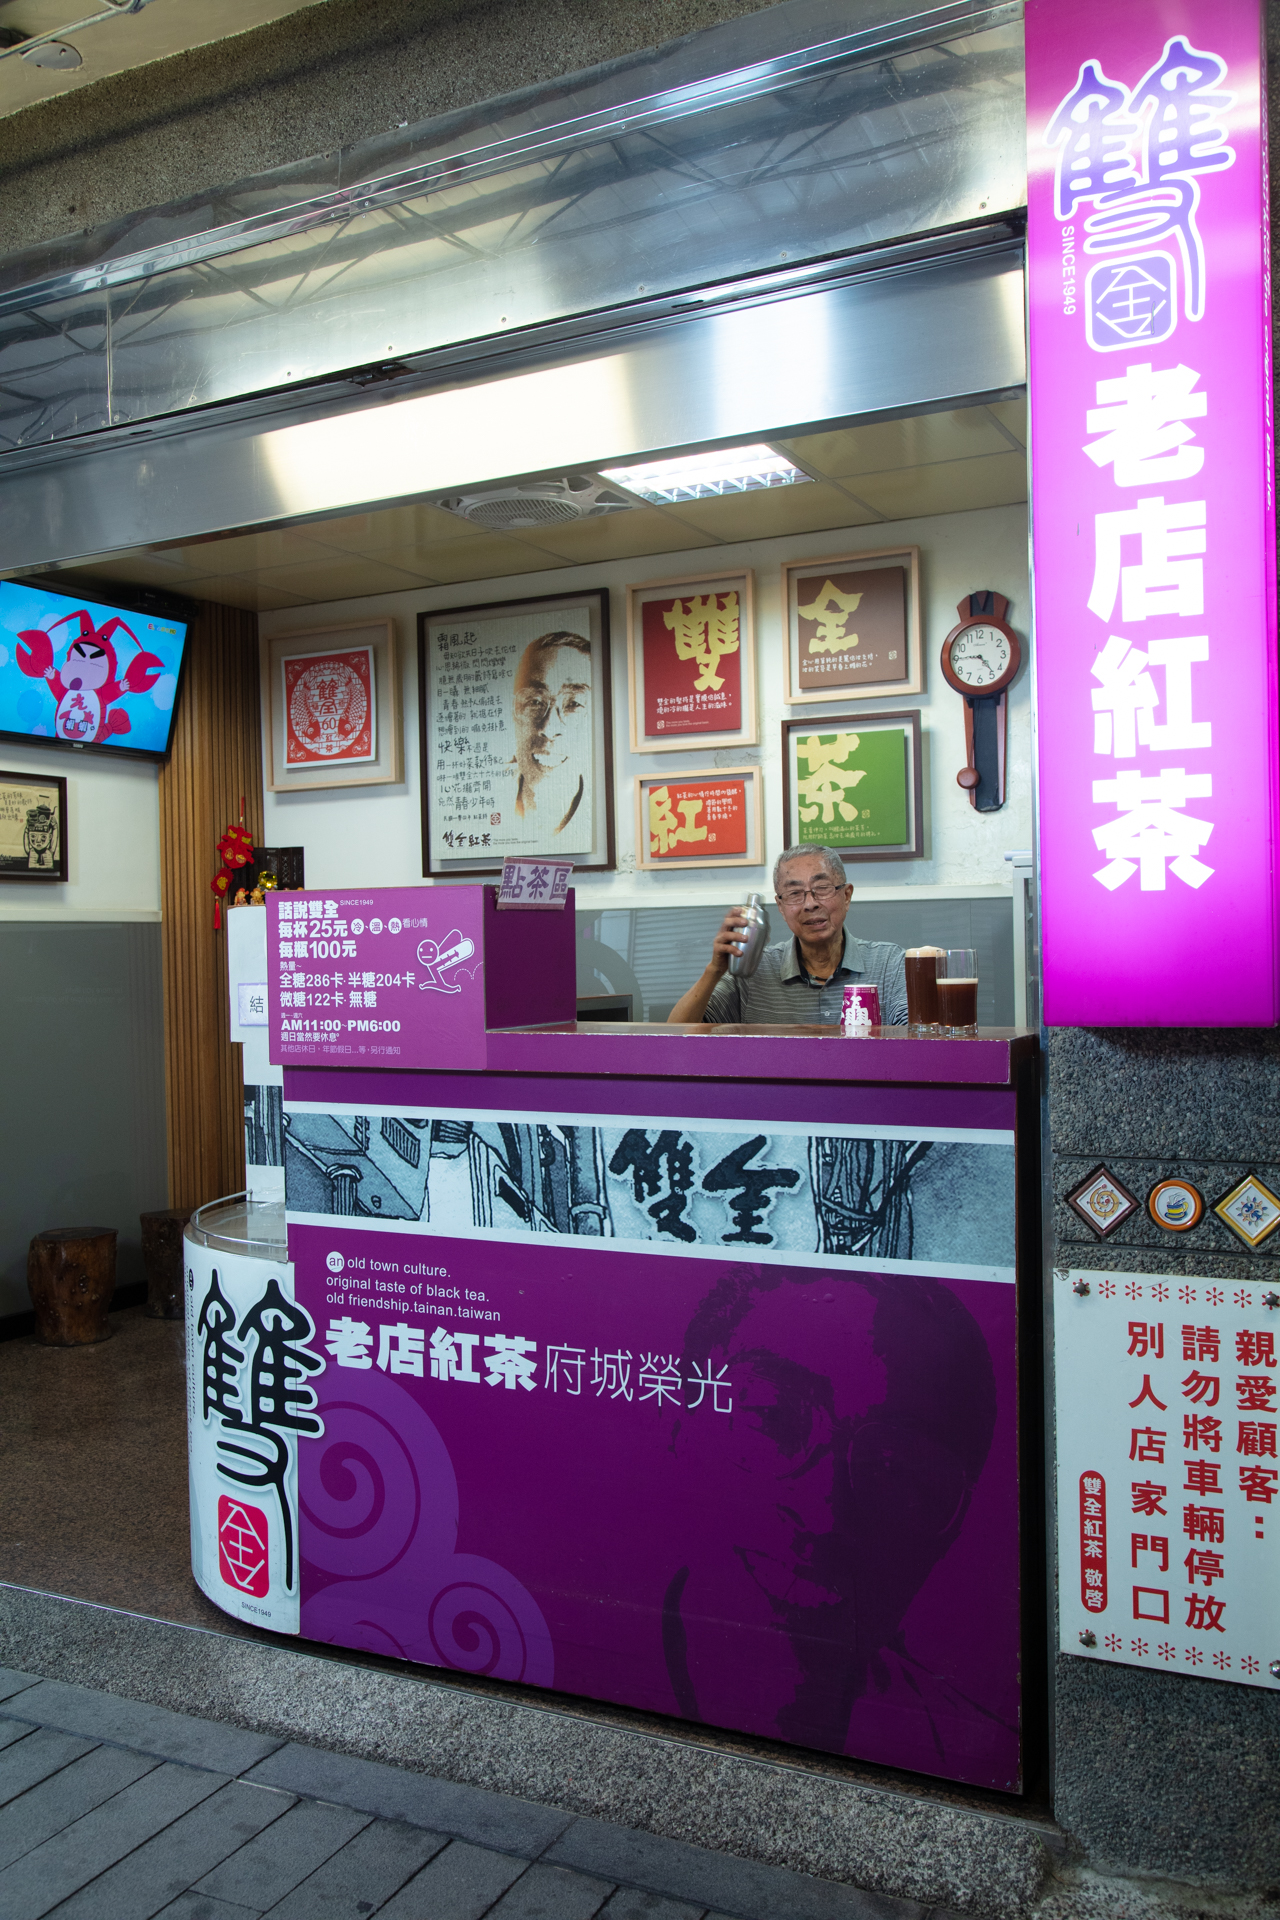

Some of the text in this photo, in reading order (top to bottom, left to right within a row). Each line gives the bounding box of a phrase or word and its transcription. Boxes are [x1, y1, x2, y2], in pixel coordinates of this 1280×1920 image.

[1062, 226, 1076, 315] SINCE1949
[797, 580, 864, 654] 全
[1083, 362, 1215, 891] 老店紅茶
[662, 591, 740, 692] 雙
[966, 634, 974, 643] 11
[975, 630, 984, 640] 12
[989, 632, 994, 641] 1
[996, 639, 1003, 648] 2
[957, 644, 966, 653] 10
[1000, 650, 1007, 659] 3
[957, 666, 963, 675] 8
[966, 672, 972, 681] 7
[977, 675, 983, 684] 6
[989, 670, 995, 680] 5
[321, 717, 336, 731] 60
[797, 734, 867, 824] 茶
[649, 786, 707, 854] 紅
[442, 830, 492, 848] 雙全紅茶
[500, 865, 571, 900] 點茶區
[278, 900, 339, 919] 話說雙全
[278, 920, 348, 939] 每杯25元
[278, 940, 357, 959] 每瓶100元
[250, 996, 264, 1013] 結
[608, 1127, 800, 1246] 雙全
[347, 1257, 366, 1269] old
[370, 1258, 399, 1273] town
[403, 1263, 451, 1278] culture.
[326, 1275, 490, 1302] original taste of black tea.
[326, 1292, 501, 1321] old friendship.tainan.taiwan
[324, 1316, 732, 1413] 老店紅茶 府城榮光
[1235, 1329, 1279, 1539] 親愛顧客：
[1127, 1321, 1170, 1624] 別人店家門口
[1181, 1324, 1226, 1633] 請勿將車輛停放
[1083, 1476, 1104, 1558] 雙全紅茶
[241, 1601, 272, 1617] SINCE1949
